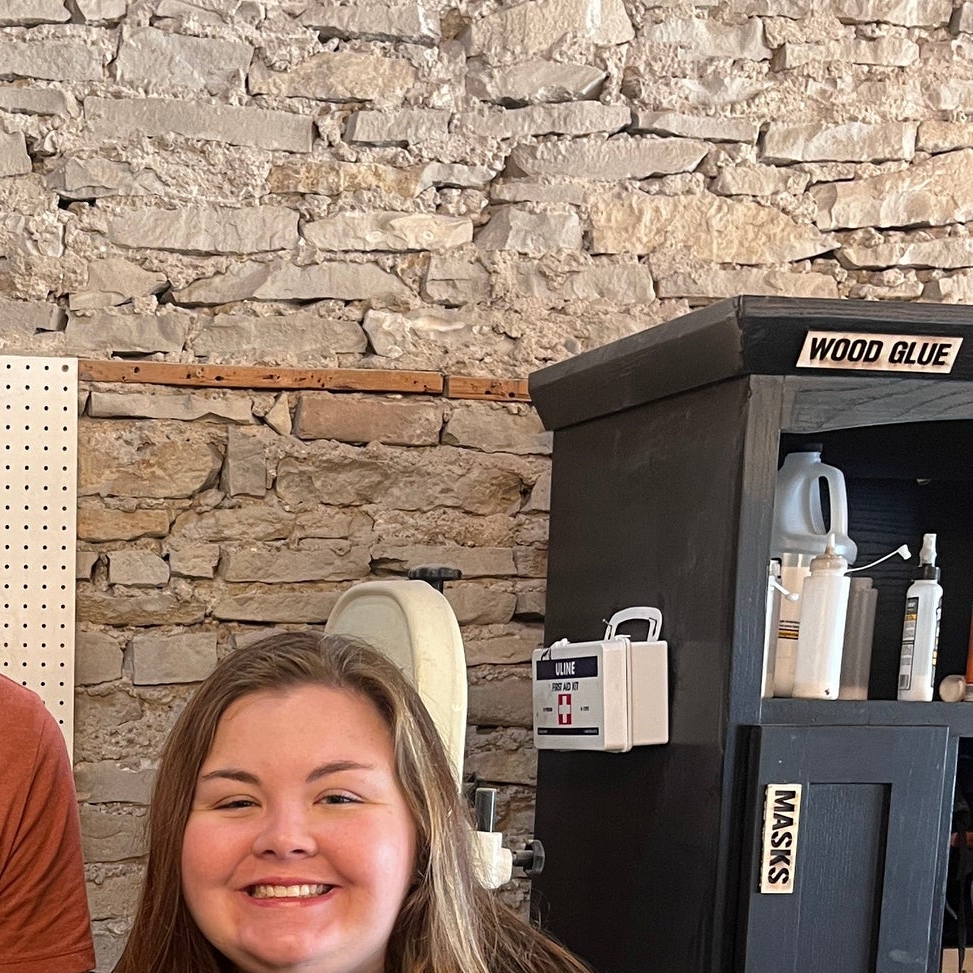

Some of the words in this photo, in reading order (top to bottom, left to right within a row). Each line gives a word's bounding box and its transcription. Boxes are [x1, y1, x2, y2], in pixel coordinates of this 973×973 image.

[809, 337, 884, 363] WOOD
[888, 340, 953, 367] GLUE
[555, 661, 576, 676] ULINE
[551, 683, 563, 692] FIRST
[562, 682, 572, 691] AID
[767, 790, 797, 884] MASKS
